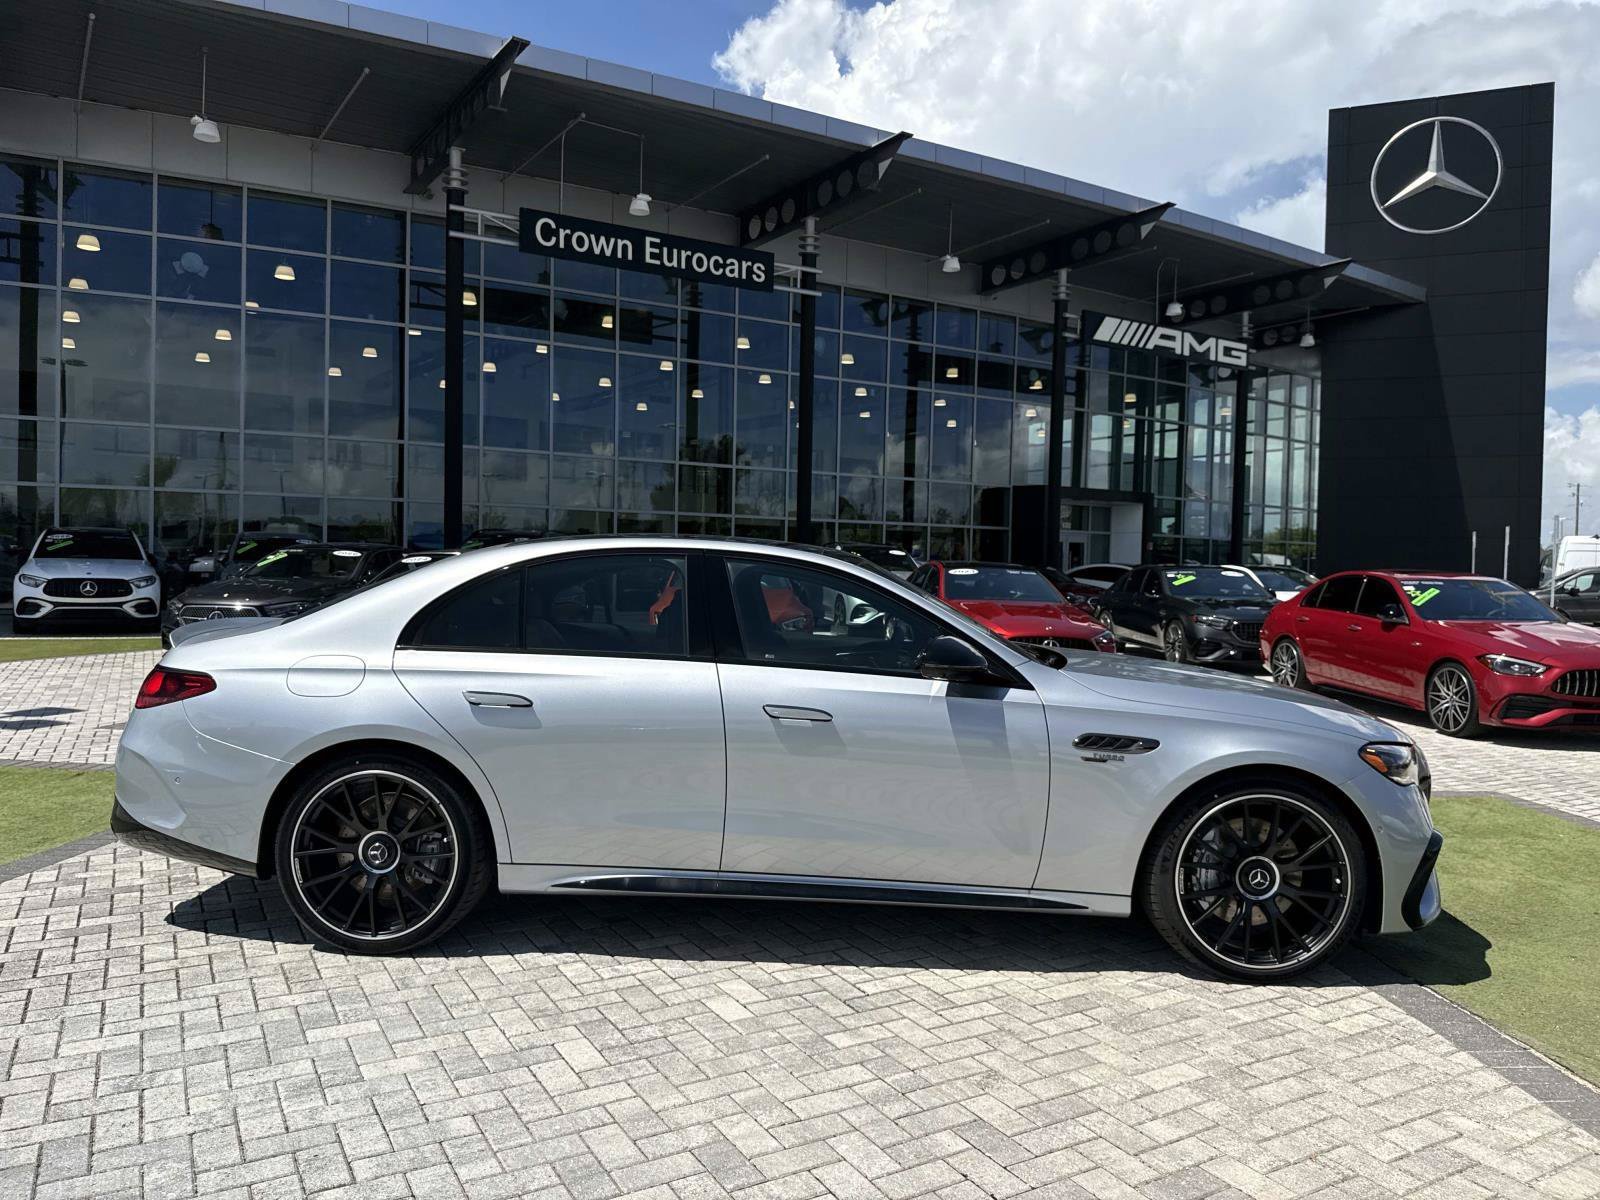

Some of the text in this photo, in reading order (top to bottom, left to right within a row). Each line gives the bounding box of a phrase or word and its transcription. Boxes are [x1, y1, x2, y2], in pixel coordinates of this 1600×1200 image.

[535, 217, 766, 283] Crown Eurocars
[1145, 326, 1248, 367] AMG
